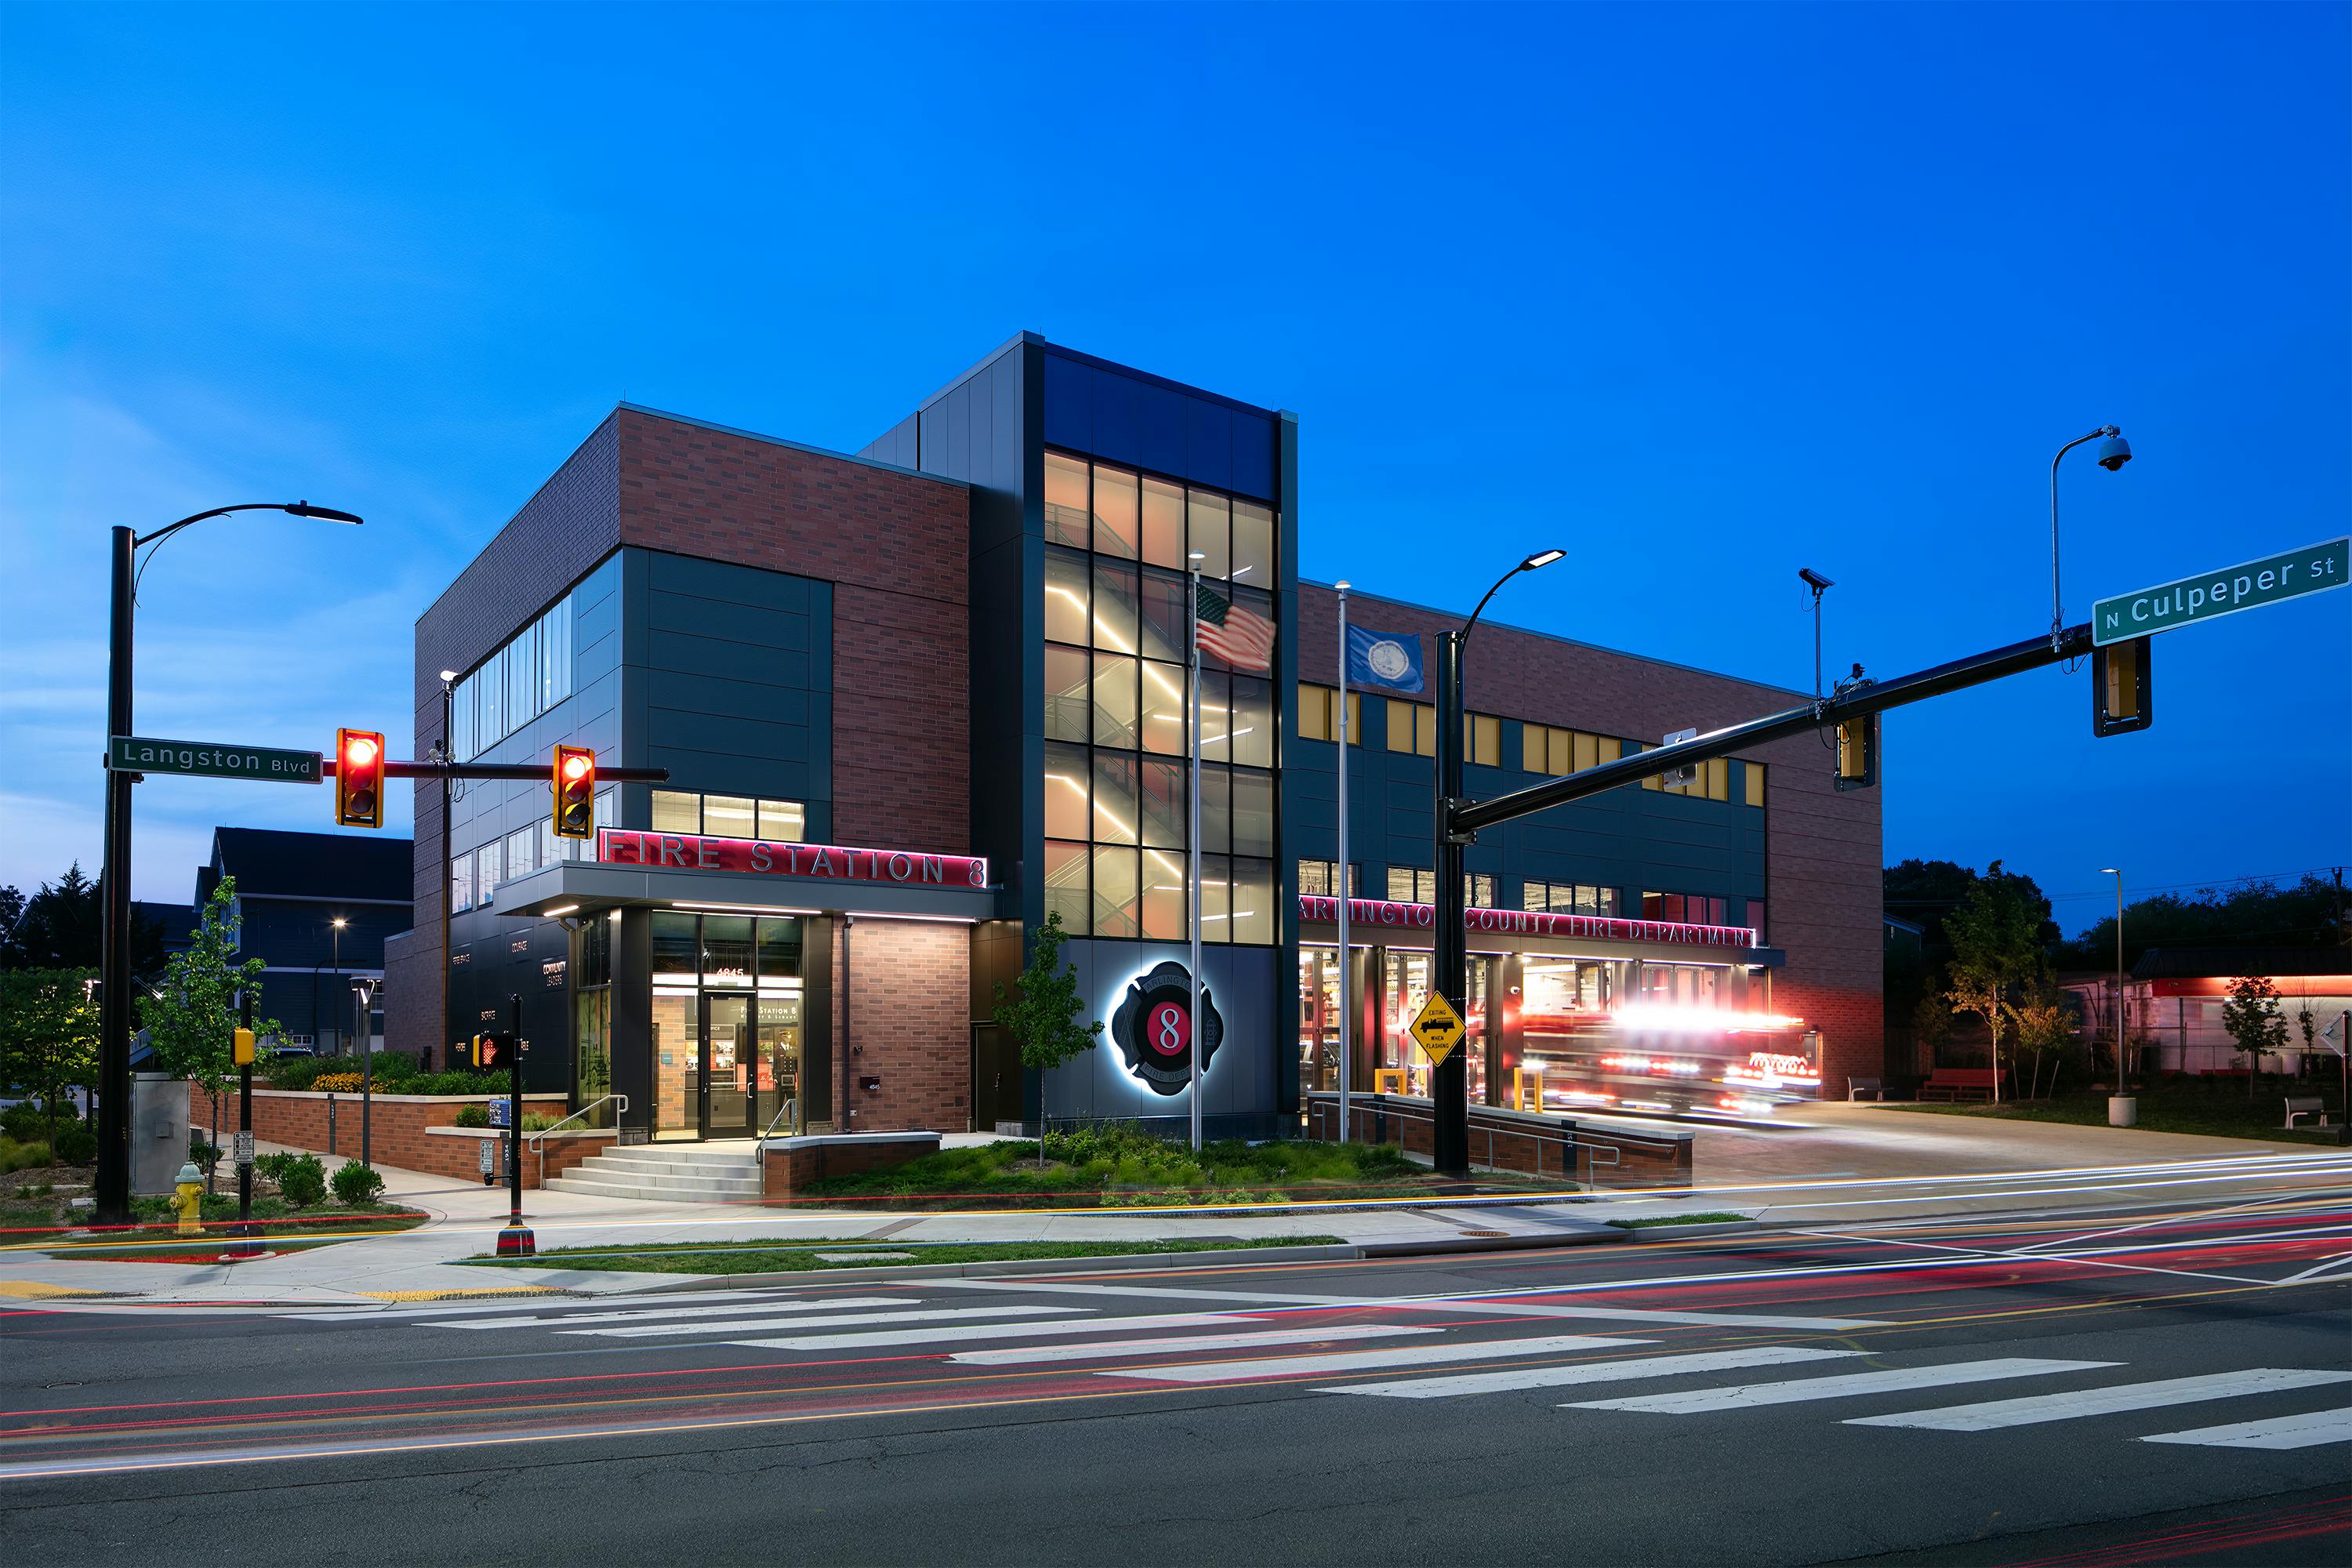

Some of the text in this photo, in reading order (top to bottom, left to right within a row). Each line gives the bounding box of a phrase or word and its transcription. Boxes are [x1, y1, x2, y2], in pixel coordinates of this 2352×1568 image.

[2106, 557, 2335, 629] N Culpeper St
[124, 743, 310, 774] Langston Blvd
[604, 831, 985, 886] FIRE STATION 8
[1465, 909, 1556, 934] COUNTY
[1570, 917, 1619, 939] FIRE
[1629, 920, 1755, 947] DEPARTMENT
[543, 961, 567, 975] COMMUNITY
[716, 967, 744, 978] 4845
[758, 1006, 788, 1014] STATION
[1160, 1008, 1180, 1049] 8
[1145, 1065, 1164, 1080] FIRE
